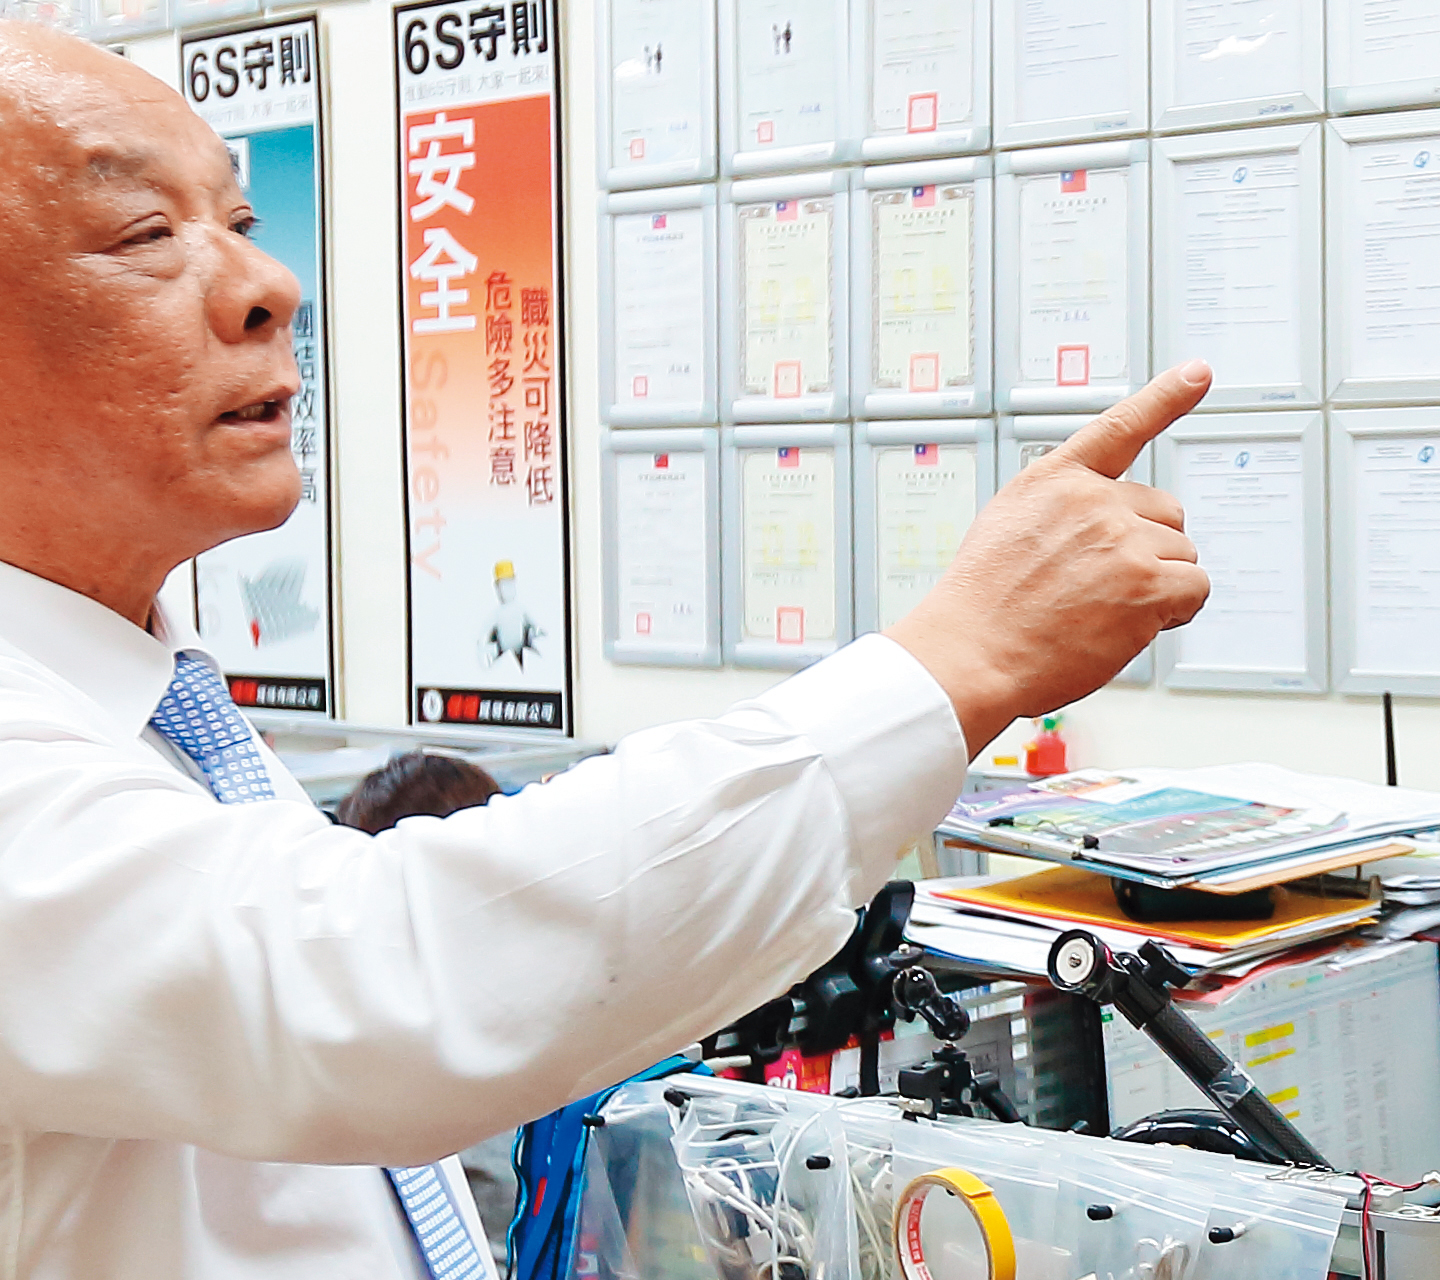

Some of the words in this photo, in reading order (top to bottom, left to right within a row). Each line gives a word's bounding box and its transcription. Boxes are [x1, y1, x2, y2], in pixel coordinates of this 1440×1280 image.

[191, 33, 311, 102] 6S守則
[409, 112, 477, 333] 安全
[411, 347, 449, 581] Safety
[485, 271, 517, 486] 危險多注意
[520, 287, 554, 507] 職災可降低
